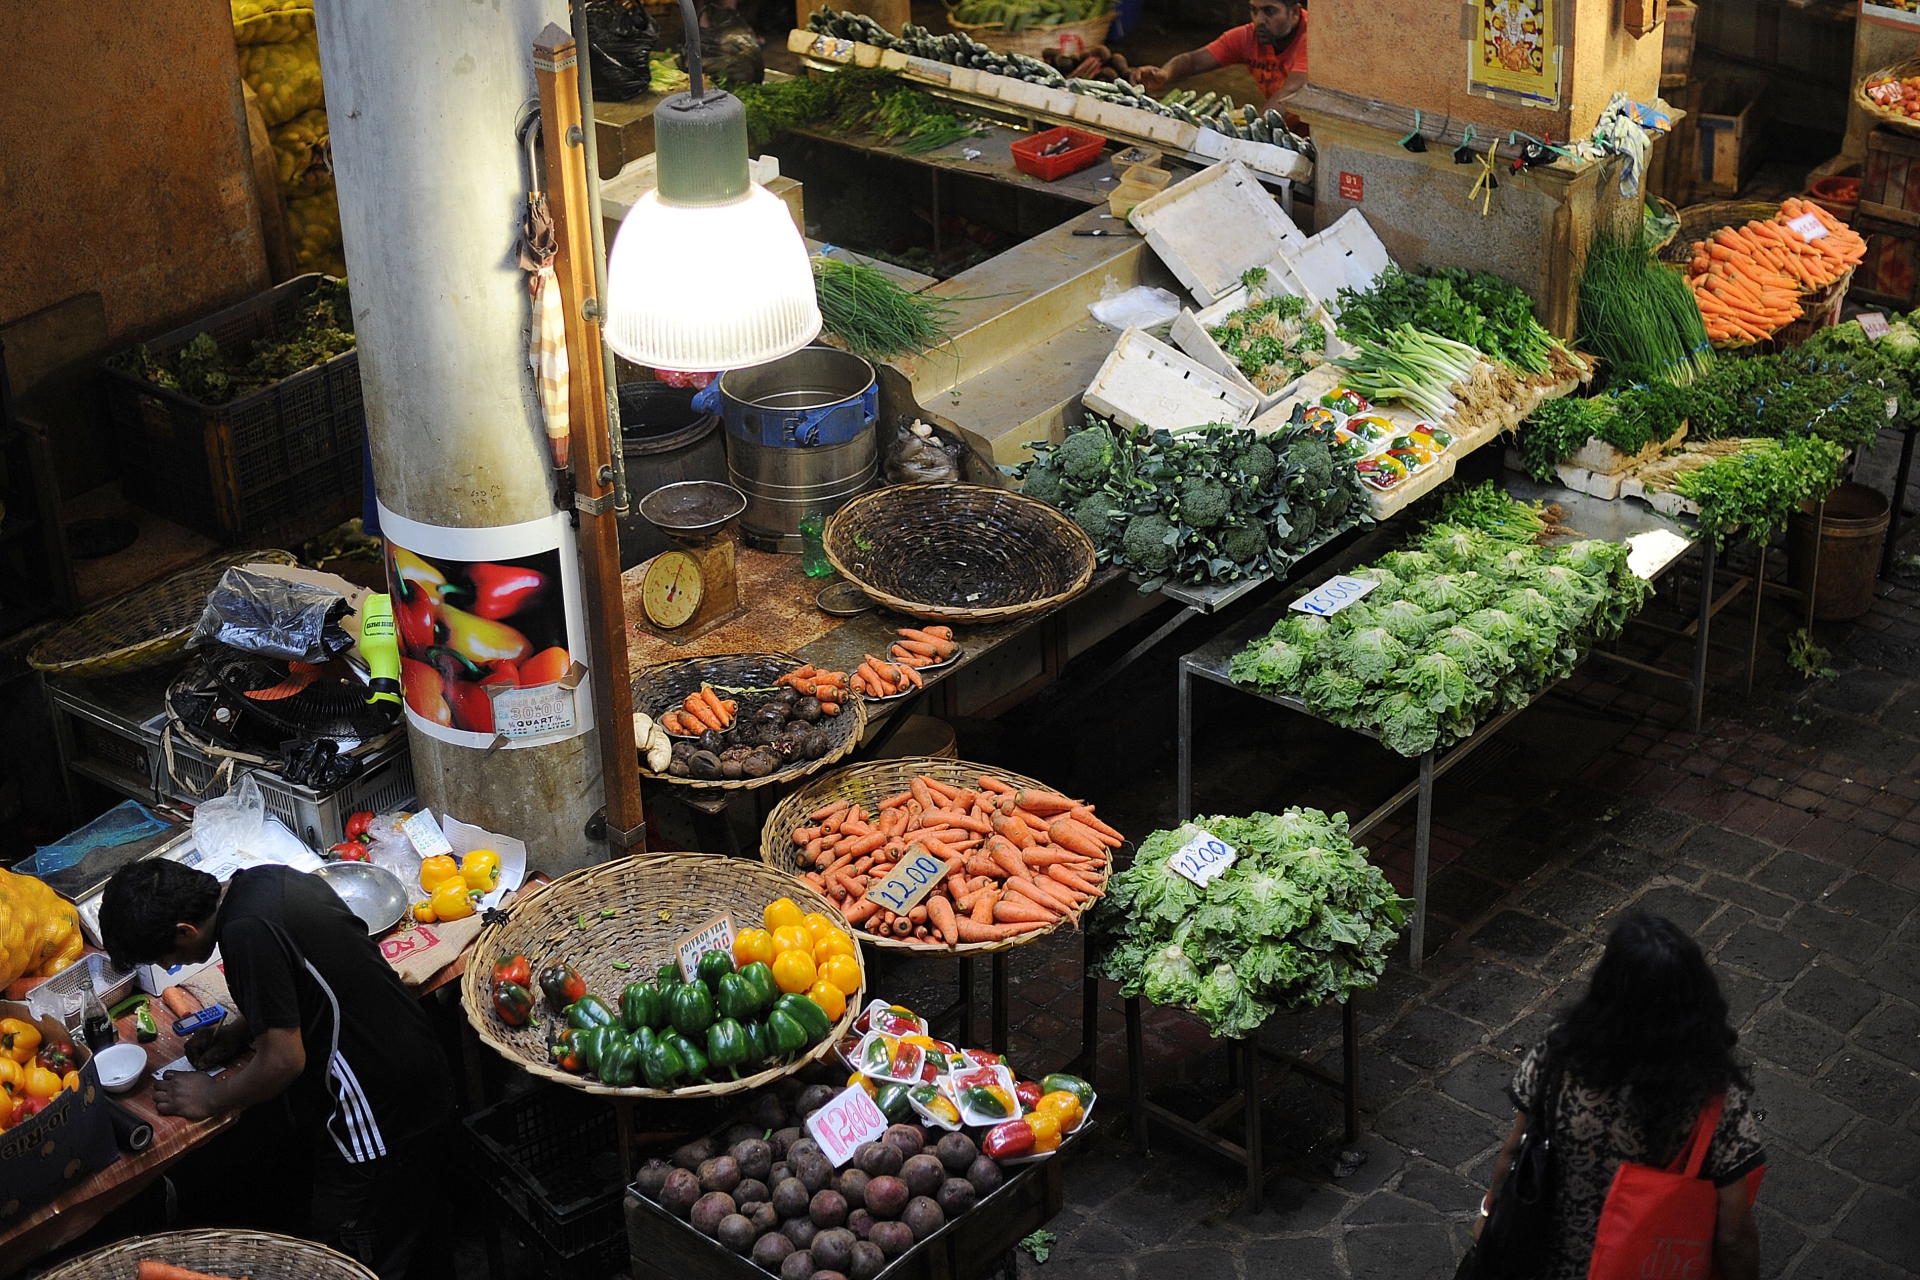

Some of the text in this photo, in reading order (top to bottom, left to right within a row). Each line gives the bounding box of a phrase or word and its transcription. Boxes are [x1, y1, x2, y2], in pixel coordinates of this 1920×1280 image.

[1345, 175, 1357, 185] 91
[510, 700, 564, 720] 30.00
[517, 716, 554, 727] QUART
[680, 920, 727, 957] POIVRON VERT
[685, 963, 694, 975] Rs
